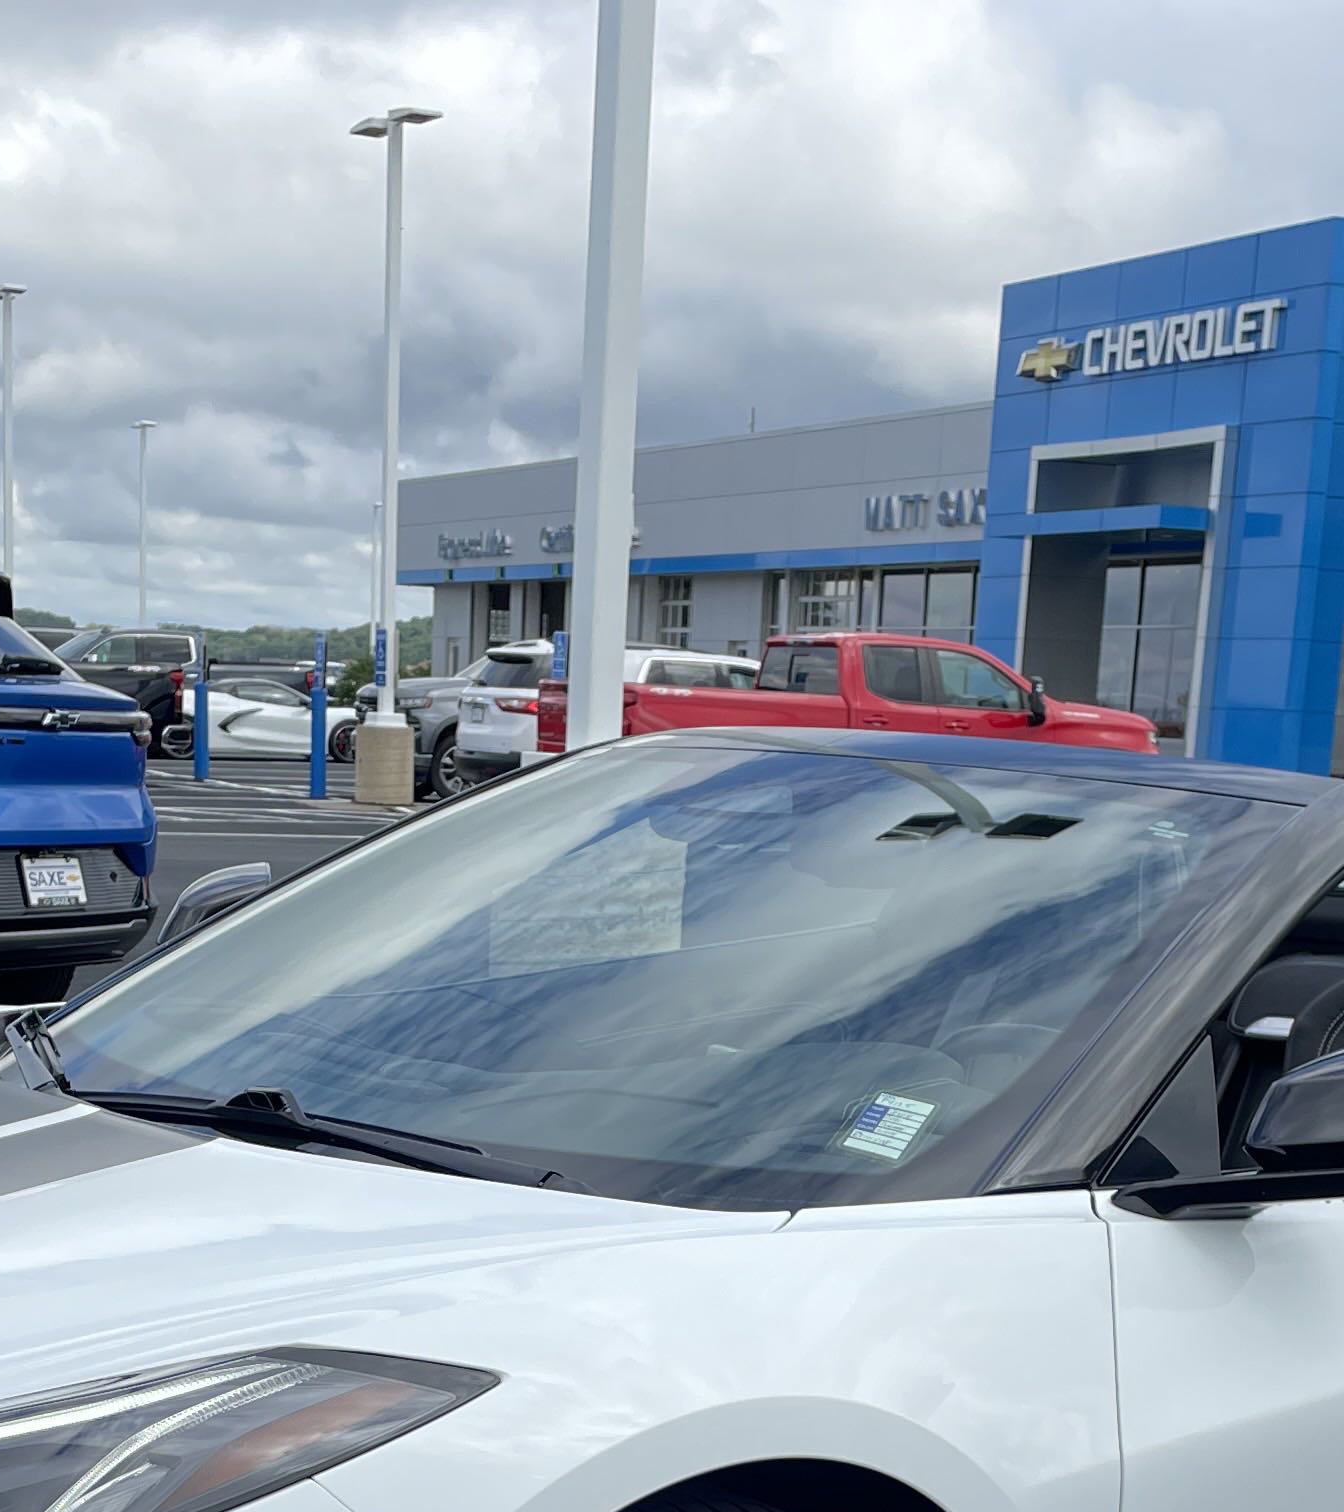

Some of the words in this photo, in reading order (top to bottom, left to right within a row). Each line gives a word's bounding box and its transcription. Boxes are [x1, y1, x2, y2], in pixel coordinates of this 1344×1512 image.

[1083, 298, 1288, 377] CHEVROLET
[864, 493, 931, 532] MATT
[29, 871, 67, 887] SAXE
